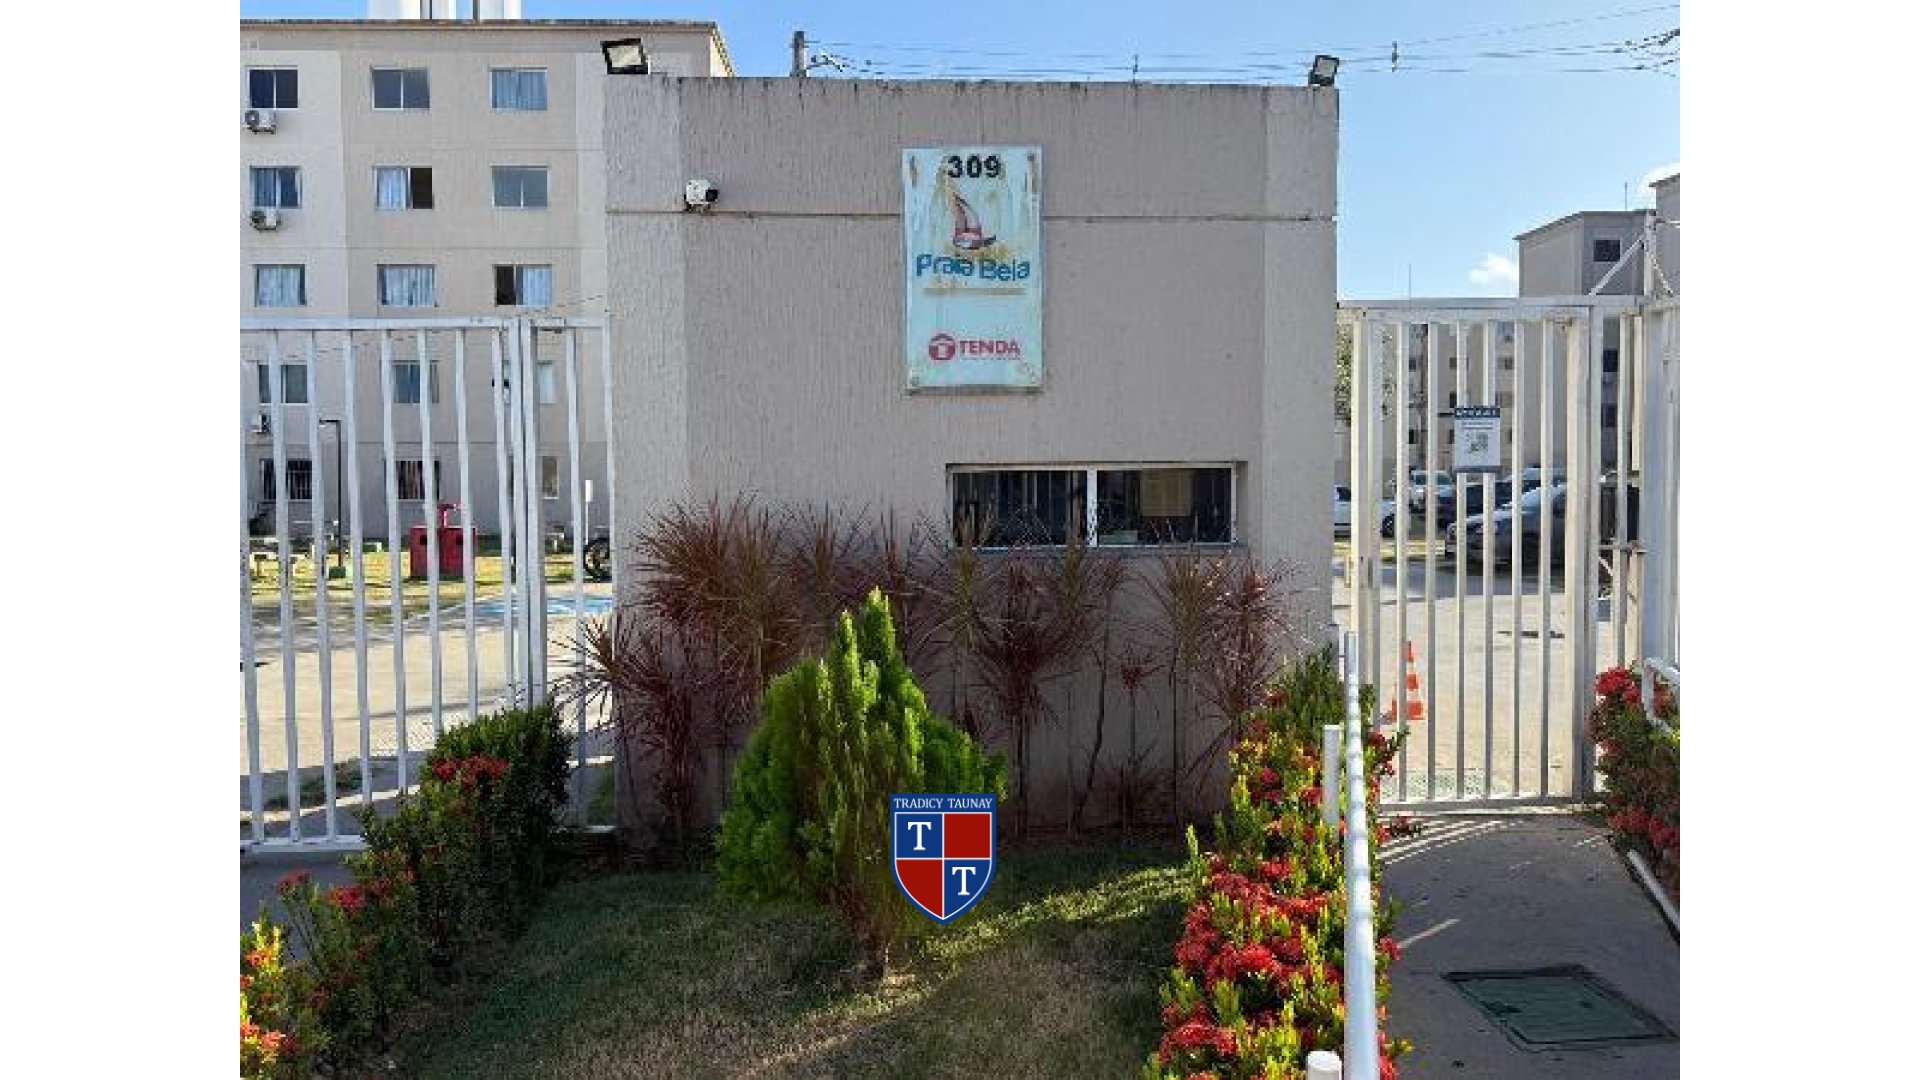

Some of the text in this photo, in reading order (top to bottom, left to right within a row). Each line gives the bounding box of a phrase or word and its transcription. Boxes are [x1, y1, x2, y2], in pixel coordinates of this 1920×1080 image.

[947, 155, 1001, 179] 309
[916, 253, 1031, 281] Praia Bela
[959, 340, 1021, 355] TENDA
